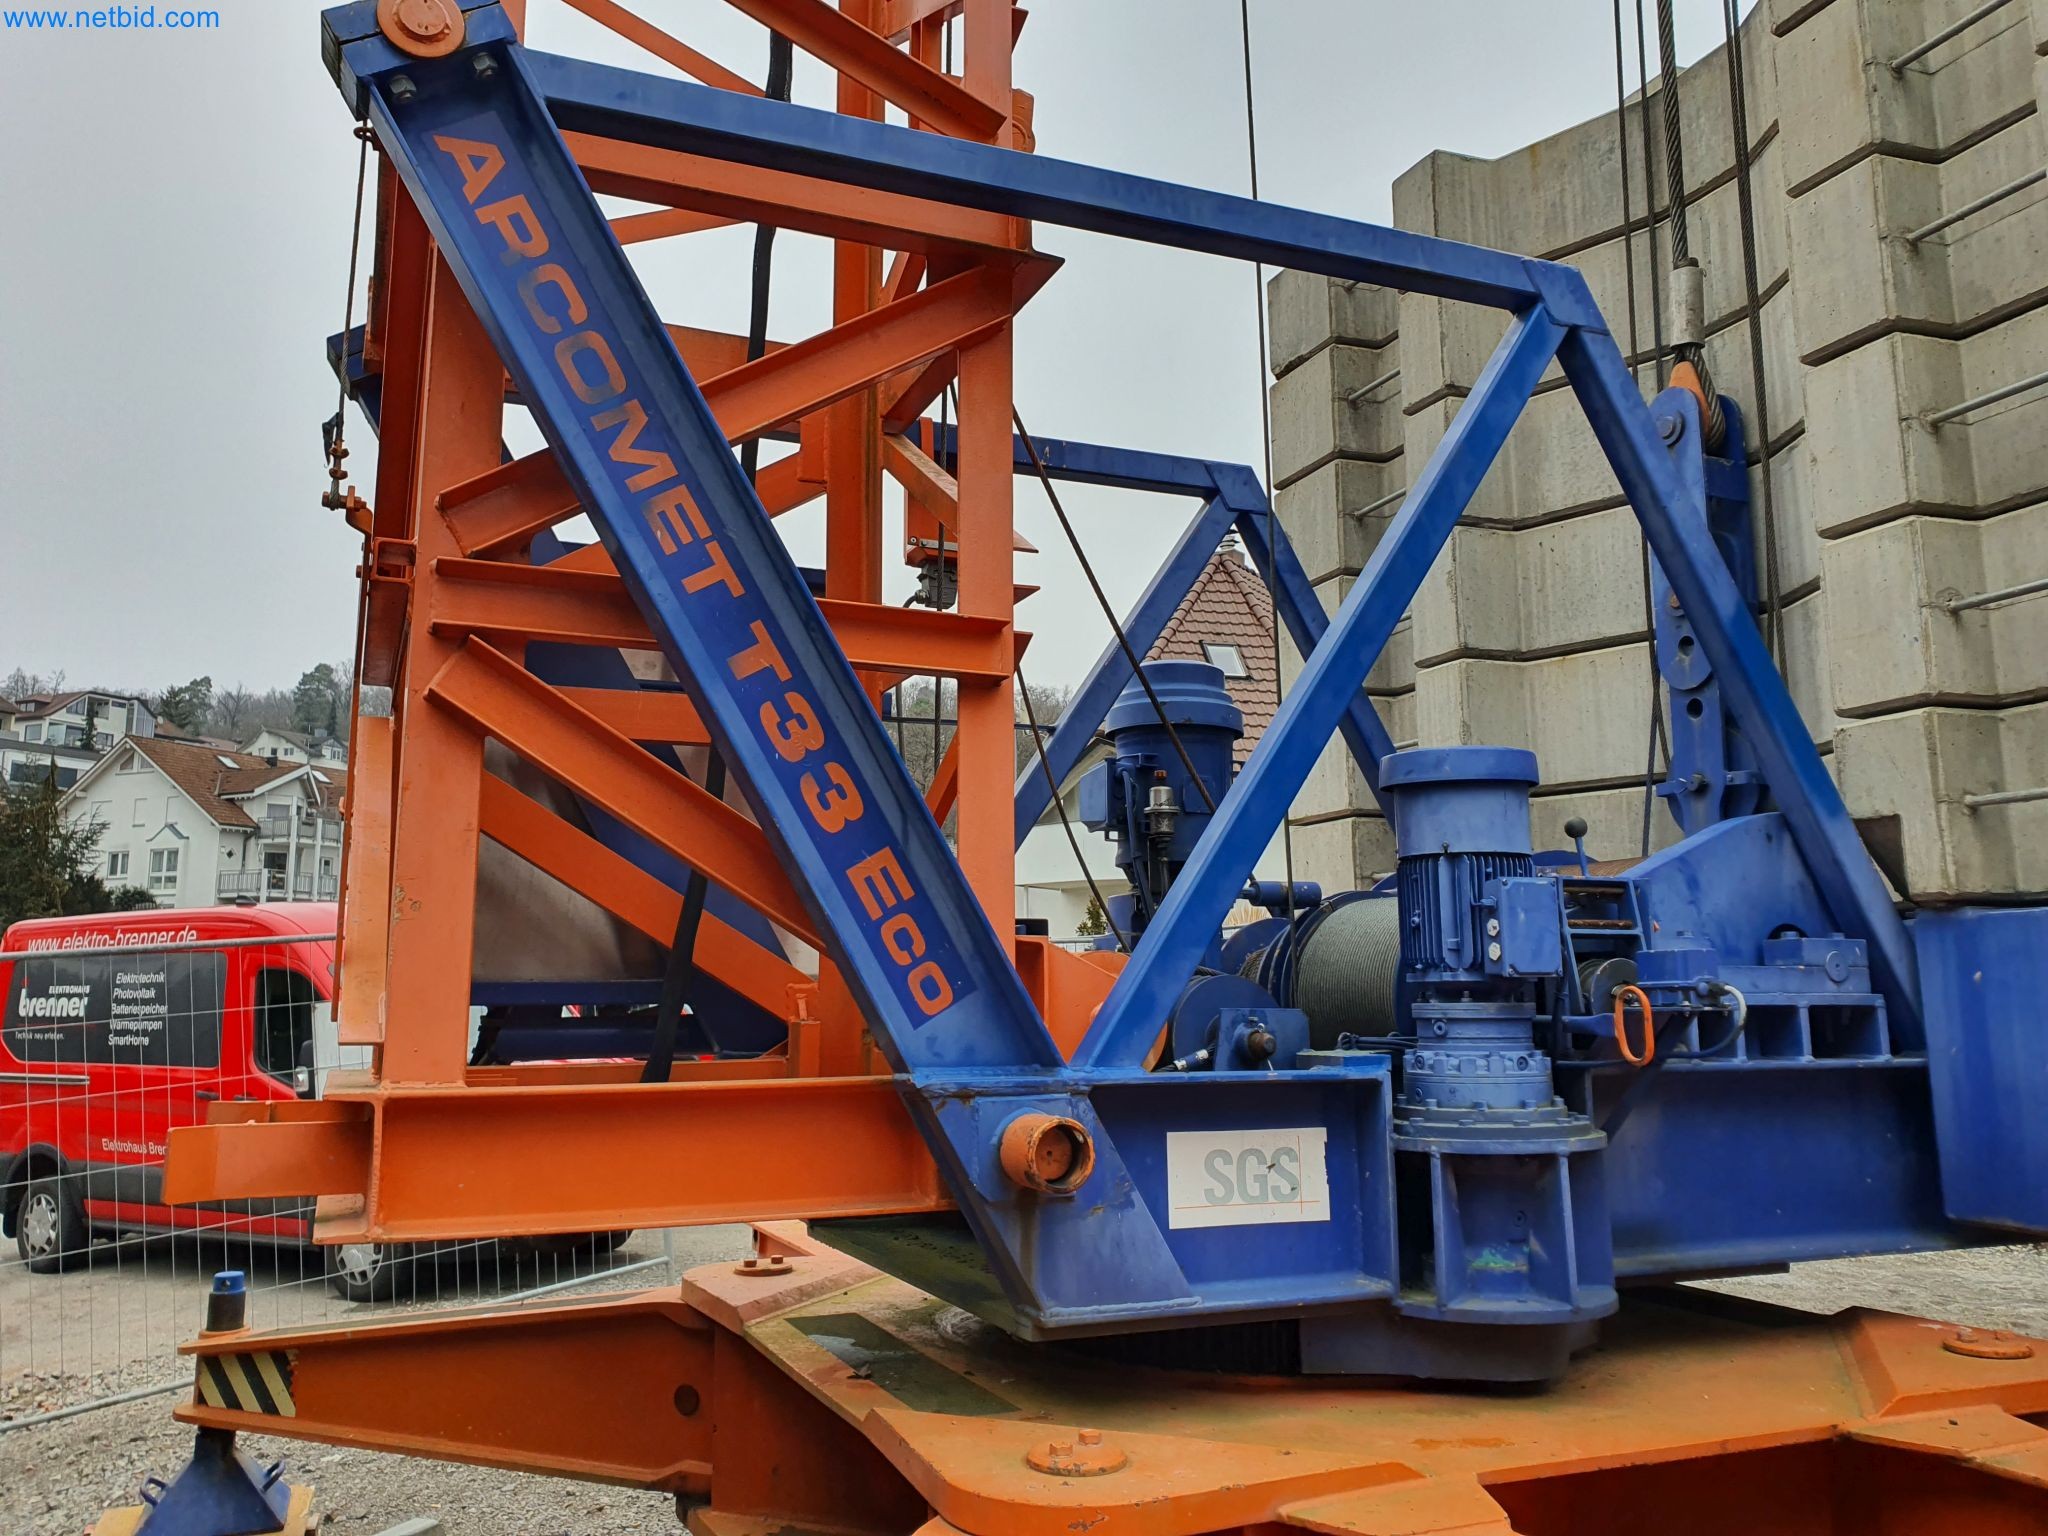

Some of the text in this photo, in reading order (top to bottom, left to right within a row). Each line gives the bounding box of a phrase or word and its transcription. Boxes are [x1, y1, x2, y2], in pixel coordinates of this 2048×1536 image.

[433, 134, 745, 598] ARCOMET
[726, 619, 864, 834] T33
[28, 925, 197, 952] wwwelektro-brennerde
[115, 971, 165, 985] Elektrotechnik
[48, 985, 91, 995] ELEKTROHAUS
[113, 987, 156, 999] Photovoltaik
[18, 988, 89, 1018] brenner
[111, 1003, 168, 1016] Batteriespeicher
[108, 1034, 149, 1047] SmartHome
[101, 1138, 148, 1154] Elektrohaus
[1203, 1147, 1300, 1206] SGS
